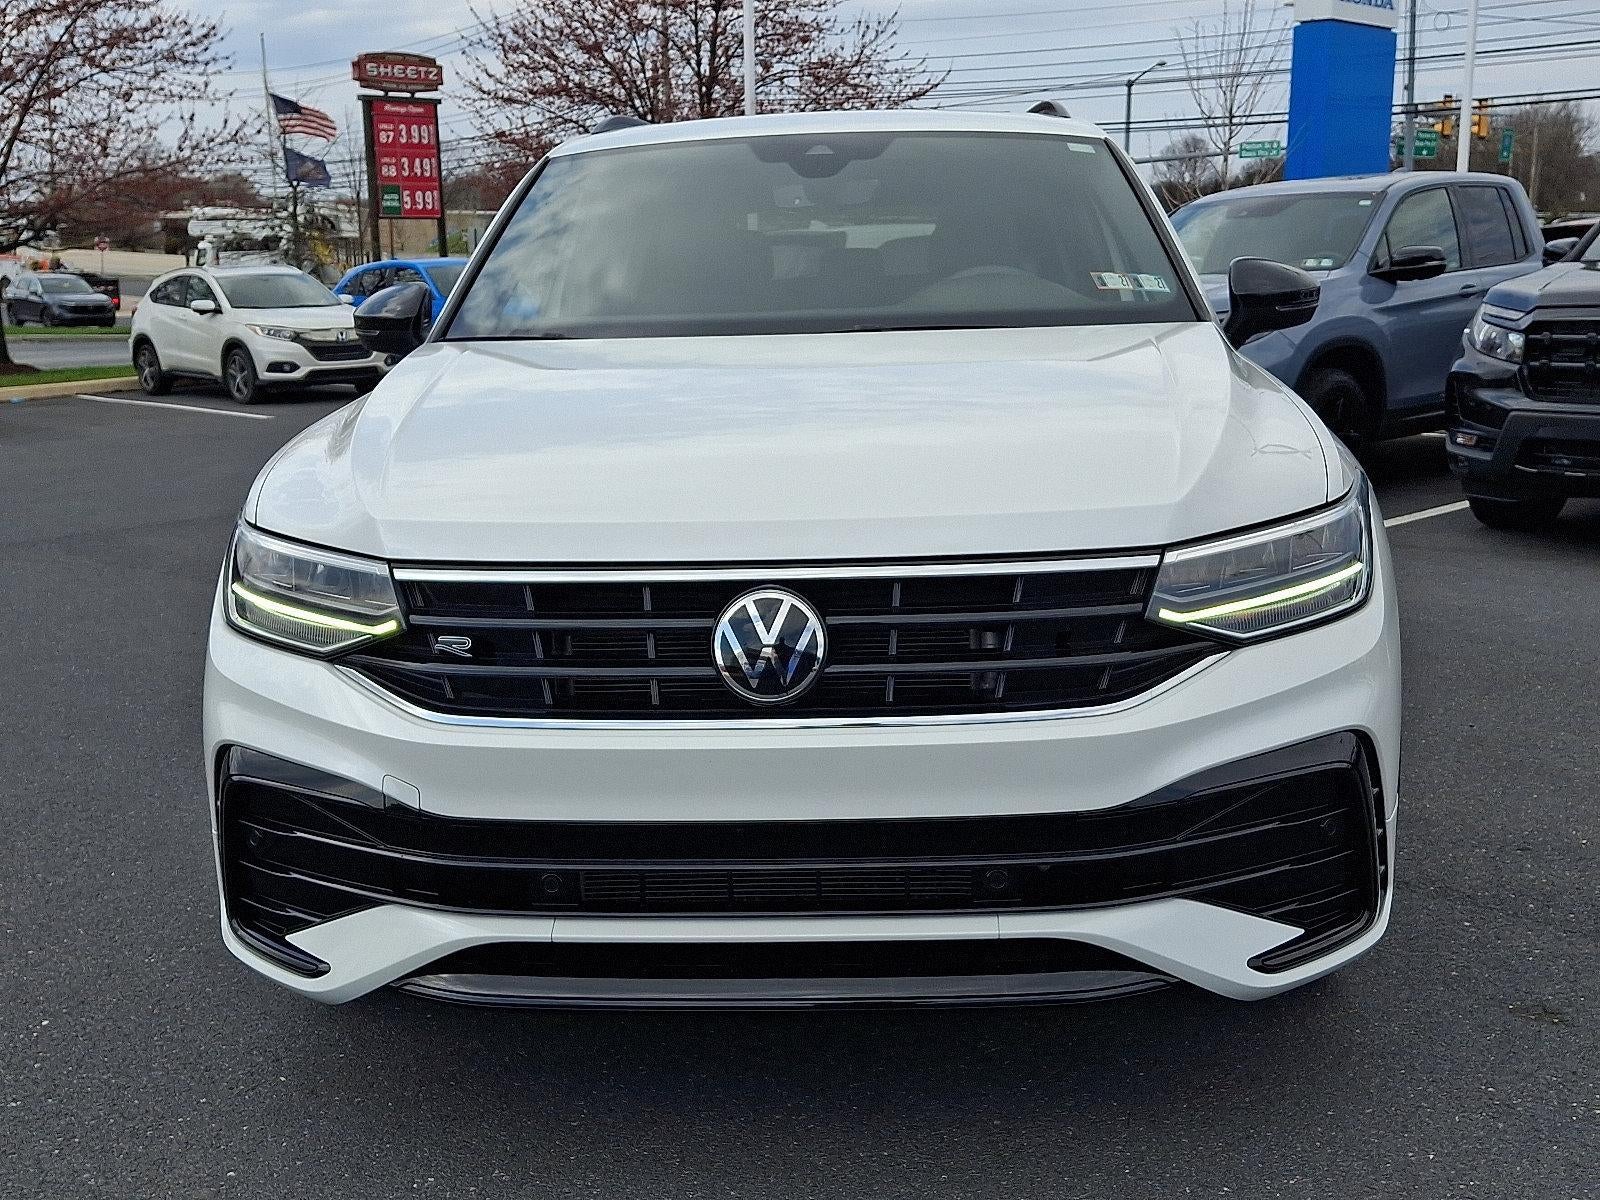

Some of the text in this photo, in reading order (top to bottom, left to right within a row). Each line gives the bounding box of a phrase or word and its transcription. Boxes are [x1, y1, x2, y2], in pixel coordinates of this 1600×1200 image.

[365, 62, 439, 80] SHEETZ
[399, 124, 429, 144] 3.99
[401, 157, 431, 177] 3.49
[403, 190, 433, 210] 5.99
[435, 635, 472, 657] R
[715, 588, 825, 702] VW
